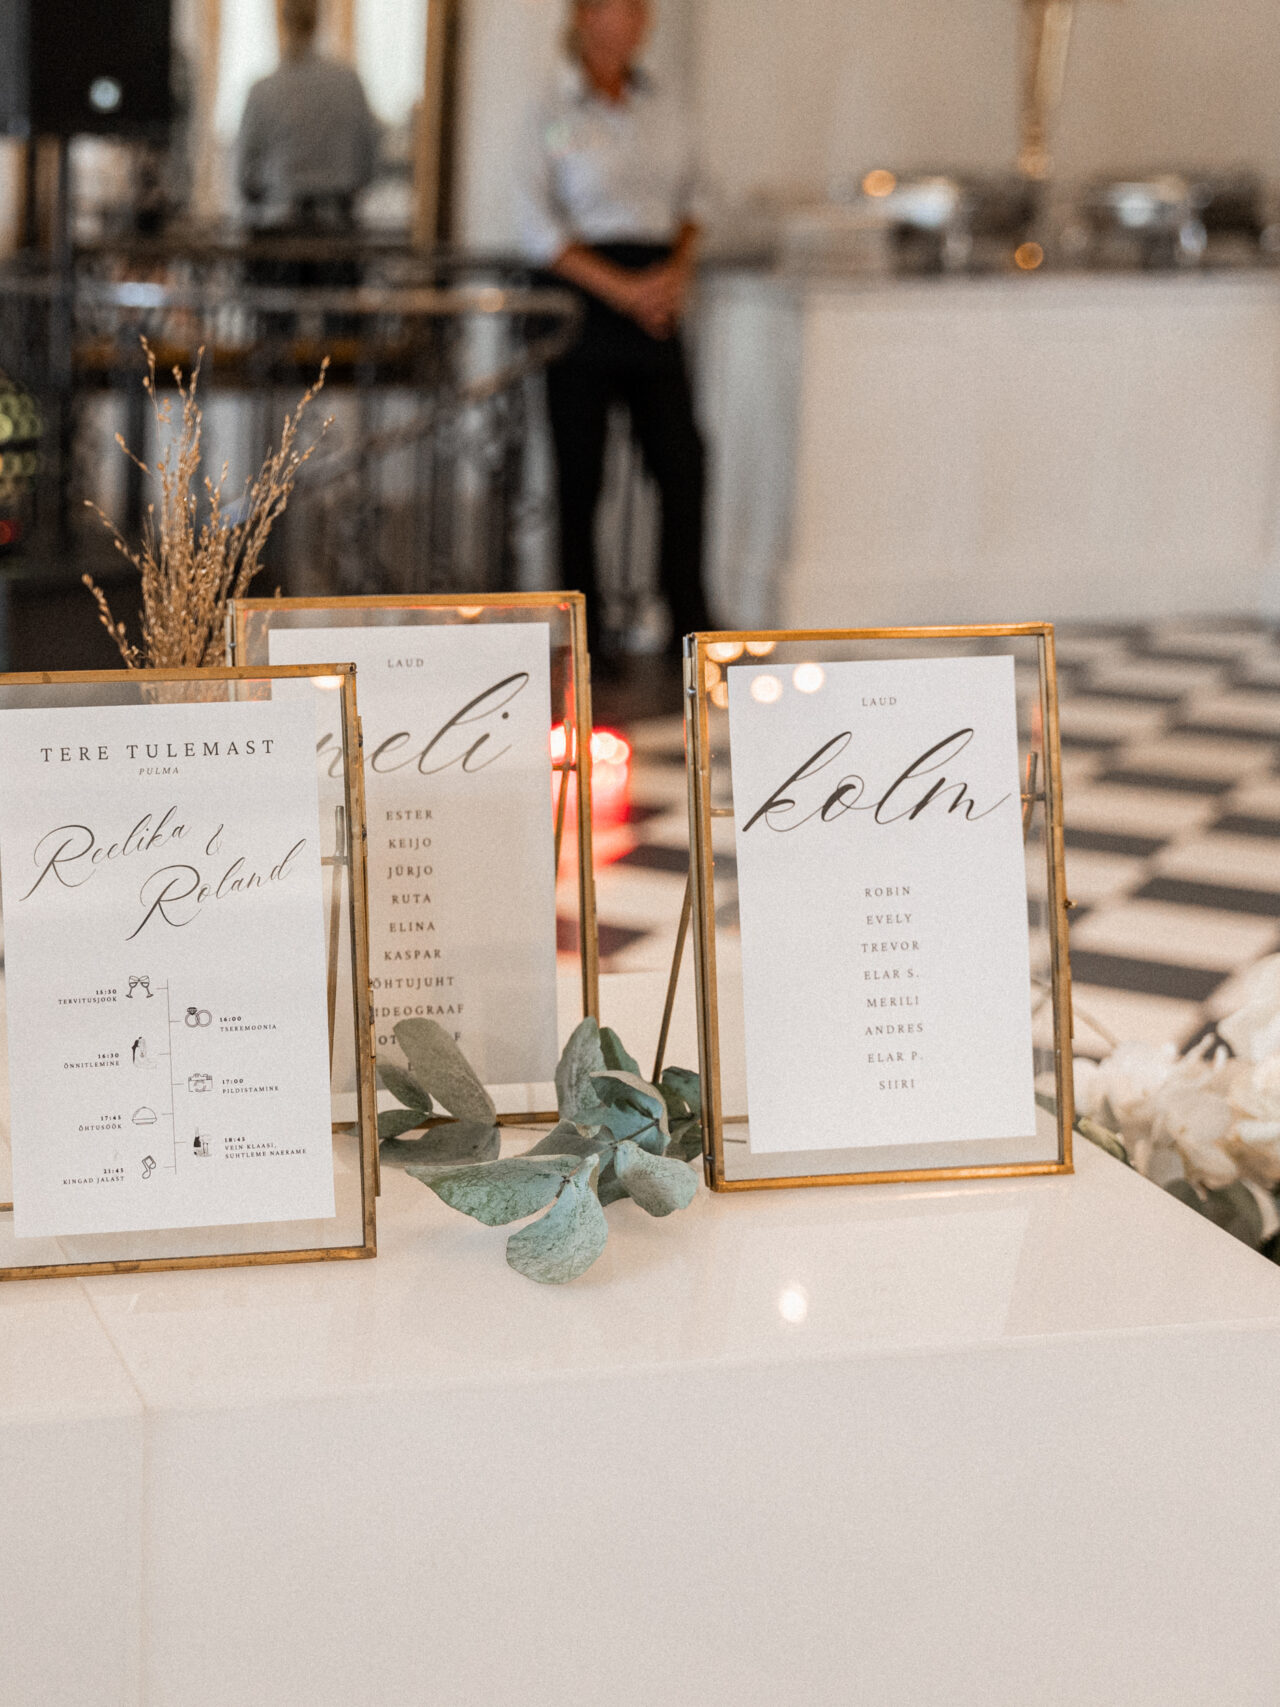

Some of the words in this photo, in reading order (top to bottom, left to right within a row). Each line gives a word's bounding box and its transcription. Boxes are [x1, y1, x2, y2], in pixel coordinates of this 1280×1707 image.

[387, 658, 425, 669] LAUD
[862, 697, 898, 708] LAUD
[40, 746, 109, 763] TERE
[126, 740, 274, 760] TULEMAST
[139, 767, 180, 776] PULMA
[742, 727, 1013, 833] kolm
[386, 810, 433, 822] ESTER
[389, 838, 433, 851] KEIJO
[20, 805, 193, 901] Reelika
[126, 838, 307, 942] Roland
[865, 886, 911, 898] ROBIN
[392, 894, 432, 905] RUTA
[866, 914, 913, 926] EVELY
[389, 922, 436, 934] ELINA
[861, 941, 920, 954] TREVOR
[384, 949, 441, 961] KASPAR
[864, 969, 901, 981] ELAR
[907, 968, 920, 979] S.
[867, 996, 919, 1009] MERILI
[375, 1004, 465, 1018] IDEOGRAAF
[865, 1023, 924, 1036] ANDRES
[868, 1052, 905, 1064] ELAR
[879, 1079, 915, 1091] SIIRI
